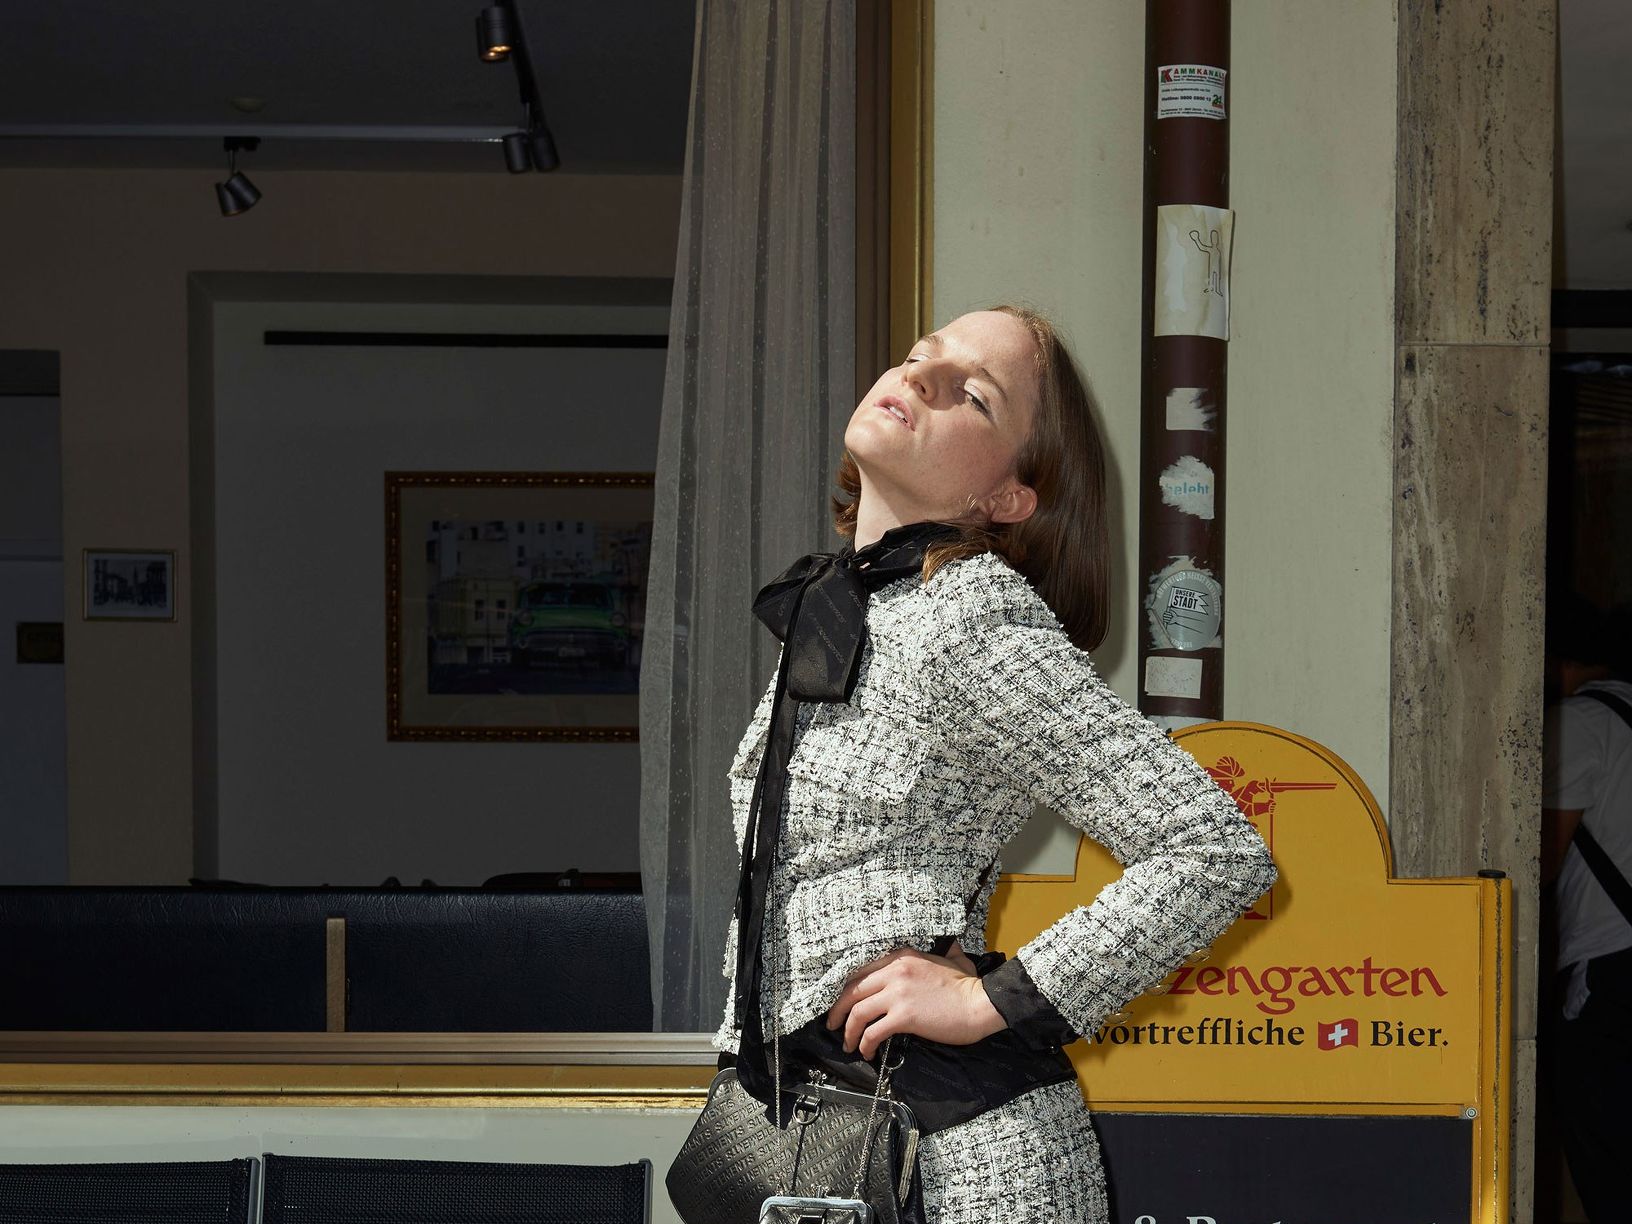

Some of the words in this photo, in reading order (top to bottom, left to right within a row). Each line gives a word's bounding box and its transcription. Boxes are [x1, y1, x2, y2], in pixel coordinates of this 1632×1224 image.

[1173, 595, 1198, 610] STADT
[1166, 956, 1448, 1015] zengarten
[1094, 1018, 1305, 1045] vortreffliche
[1370, 1020, 1449, 1046] Bier.
[690, 1124, 746, 1168] VETEMENTS
